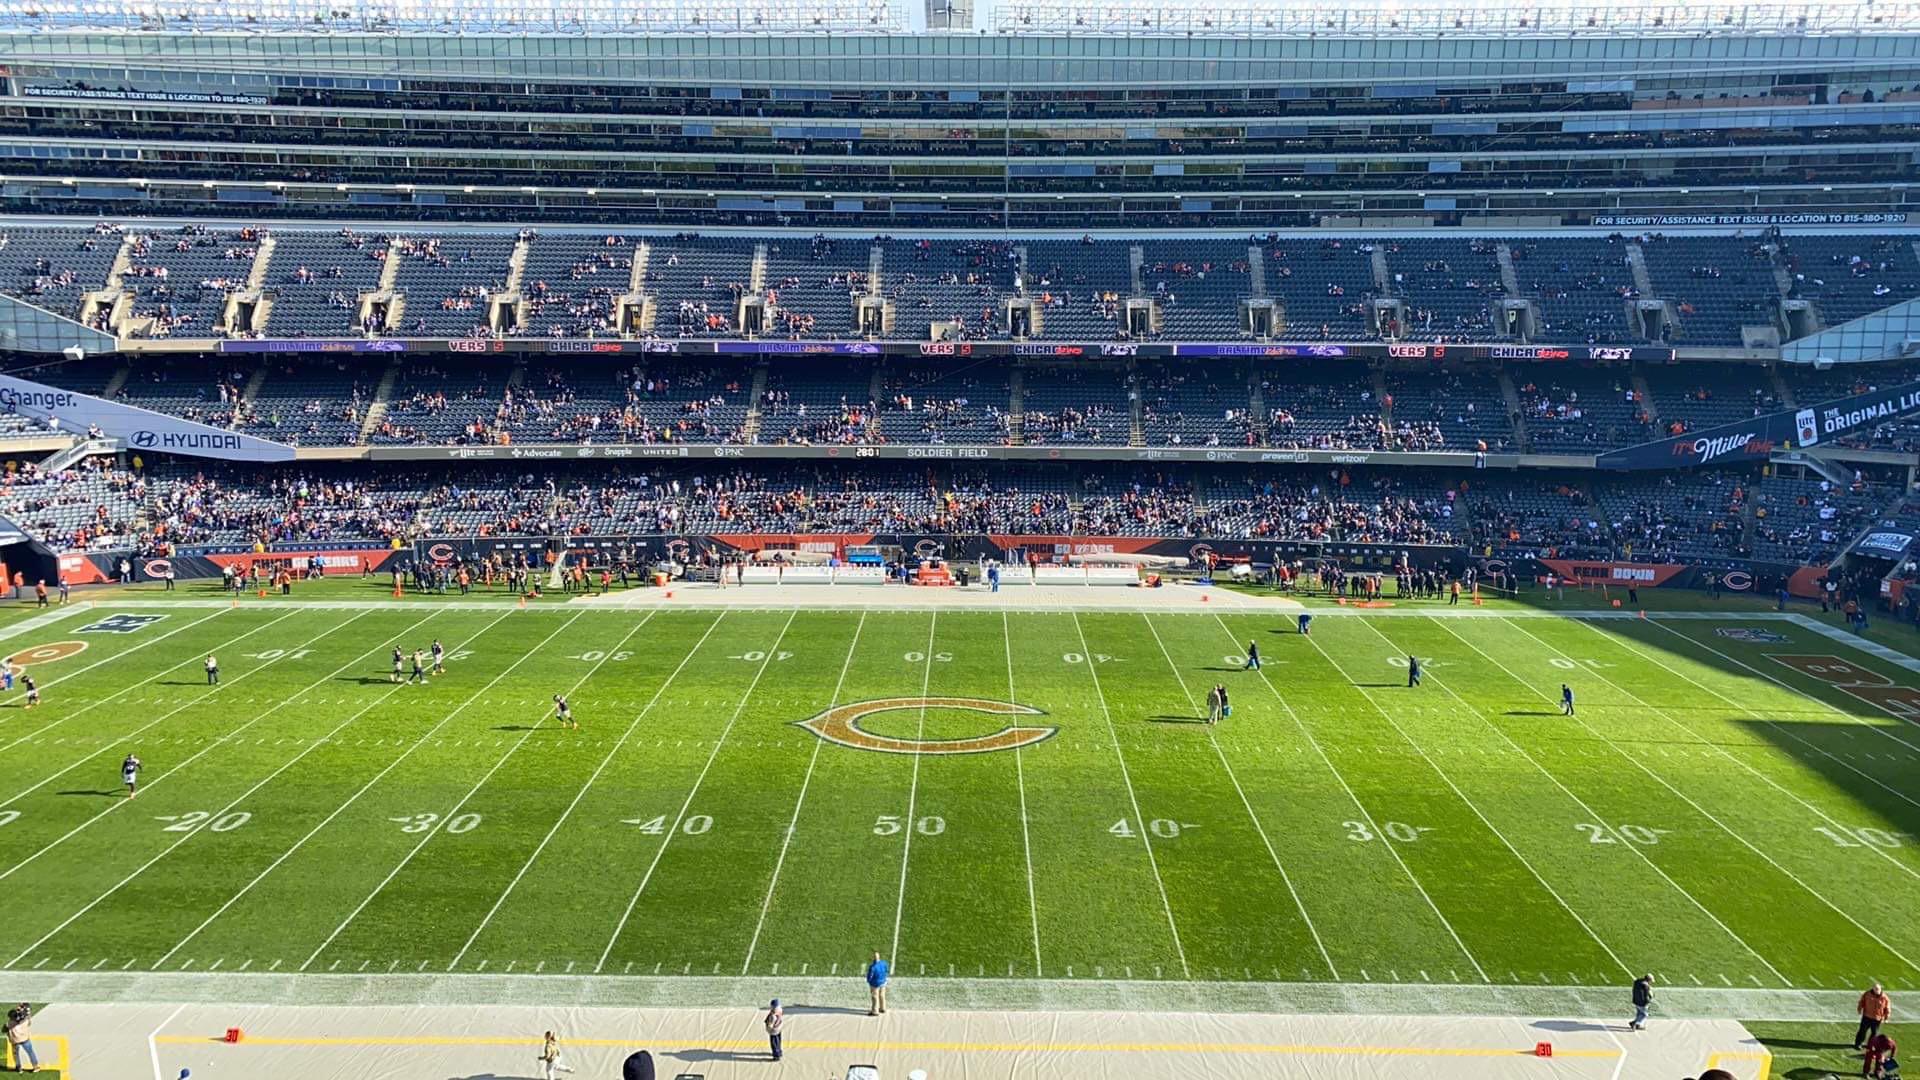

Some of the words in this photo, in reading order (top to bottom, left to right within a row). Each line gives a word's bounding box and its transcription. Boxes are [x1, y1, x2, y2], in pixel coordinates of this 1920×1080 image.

[127, 90, 145, 99] TEXT
[1595, 216, 1614, 225] FOR
[1615, 215, 1716, 225] SECURITY/ASSISTANCE
[1718, 215, 1741, 224] TEXT
[1742, 215, 1768, 224] ISSUE
[1770, 215, 1777, 223] &
[1779, 214, 1827, 223] LOCATION
[1829, 214, 1842, 223] TO
[1824, 408, 1840, 419] THE
[1825, 400, 1898, 433] ORIGINAL
[164, 432, 241, 449] HYUNDAI
[1694, 433, 1756, 464] Miller
[523, 448, 562, 457] Advocate
[643, 448, 678, 456] UNITED
[725, 448, 744, 457] PNC
[907, 448, 953, 458] SOLDIER
[958, 448, 989, 458] FIELD
[1217, 451, 1237, 460] PNC
[1331, 452, 1368, 463] verizon
[165, 811, 252, 832] 20
[401, 813, 482, 834] 30
[637, 815, 714, 835] 40
[872, 815, 946, 836] 50
[1108, 818, 1181, 839] 40
[1342, 821, 1419, 843] 30
[1574, 823, 1660, 845] 20
[1812, 825, 1902, 848] 10
